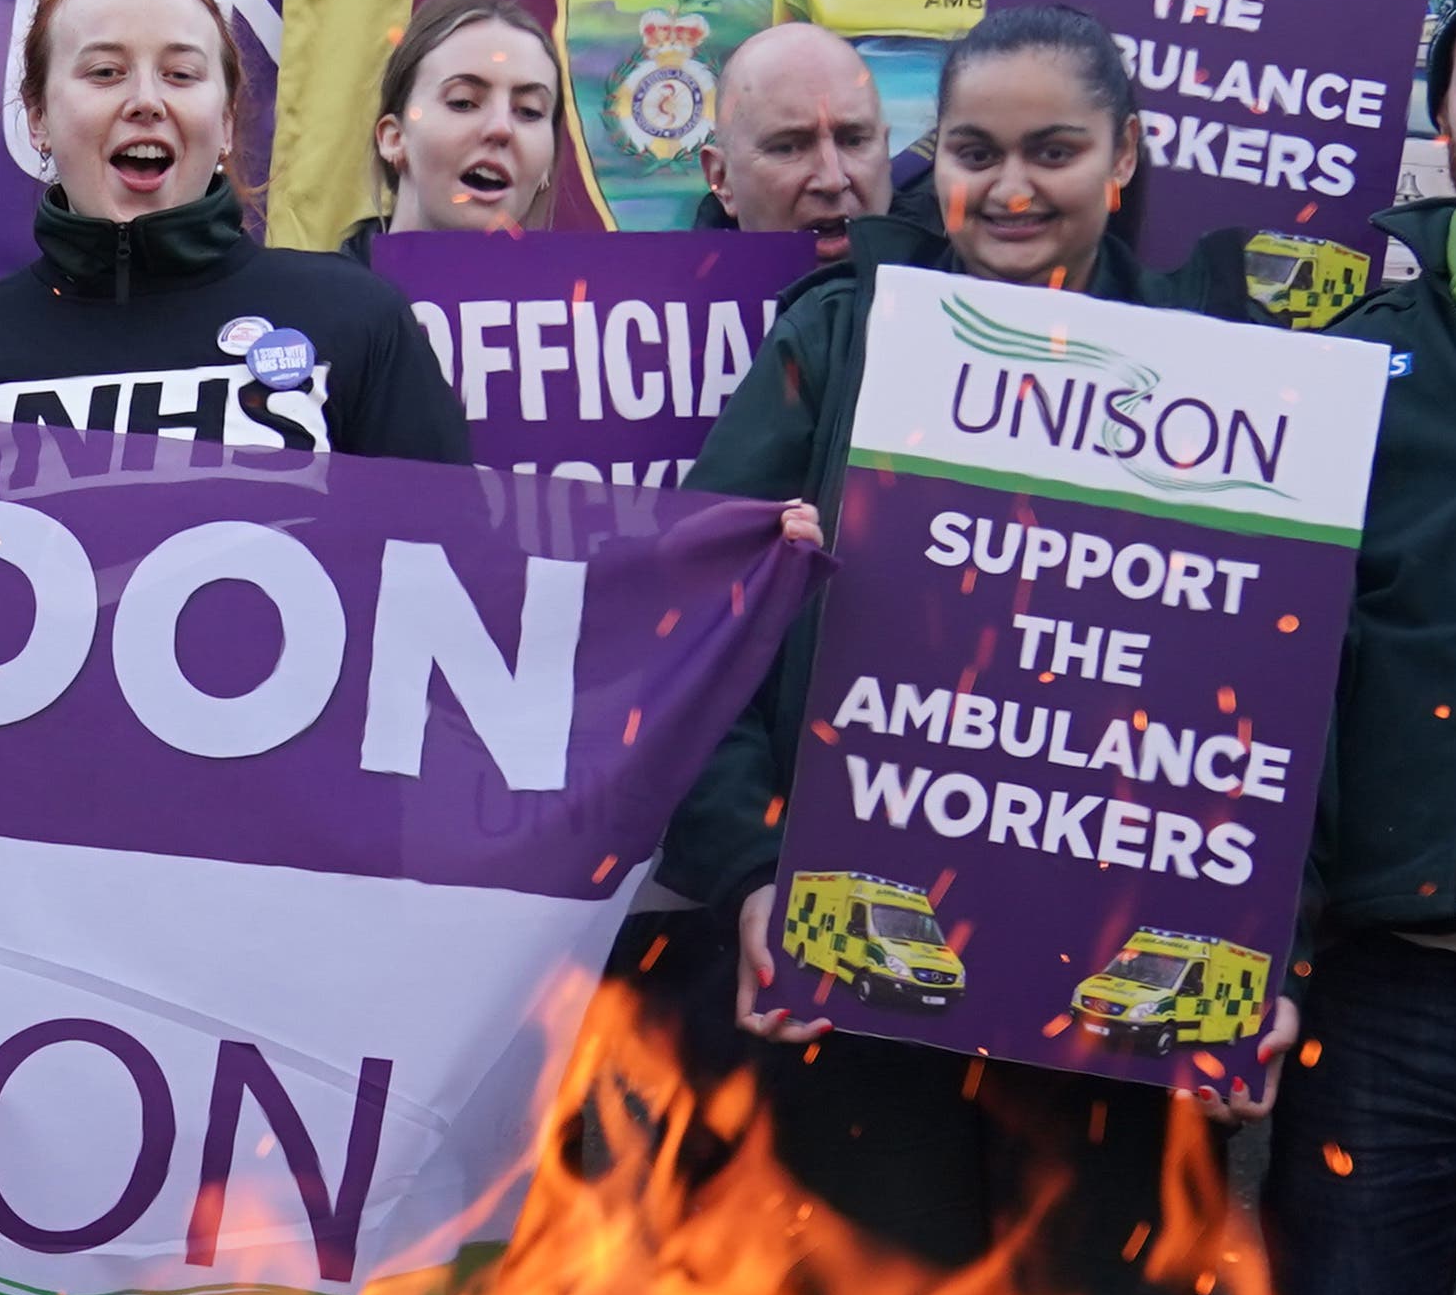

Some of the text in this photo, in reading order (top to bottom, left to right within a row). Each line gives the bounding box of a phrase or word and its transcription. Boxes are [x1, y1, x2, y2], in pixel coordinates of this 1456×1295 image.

[1138, 109, 1357, 197] RKERS
[10, 373, 316, 490] NHS
[951, 363, 1288, 484] UNISON
[925, 511, 1259, 615] SUPPORT
[1012, 615, 1151, 687] THE
[832, 676, 1292, 803] AMBULANCE
[845, 754, 1257, 885] WORKERS
